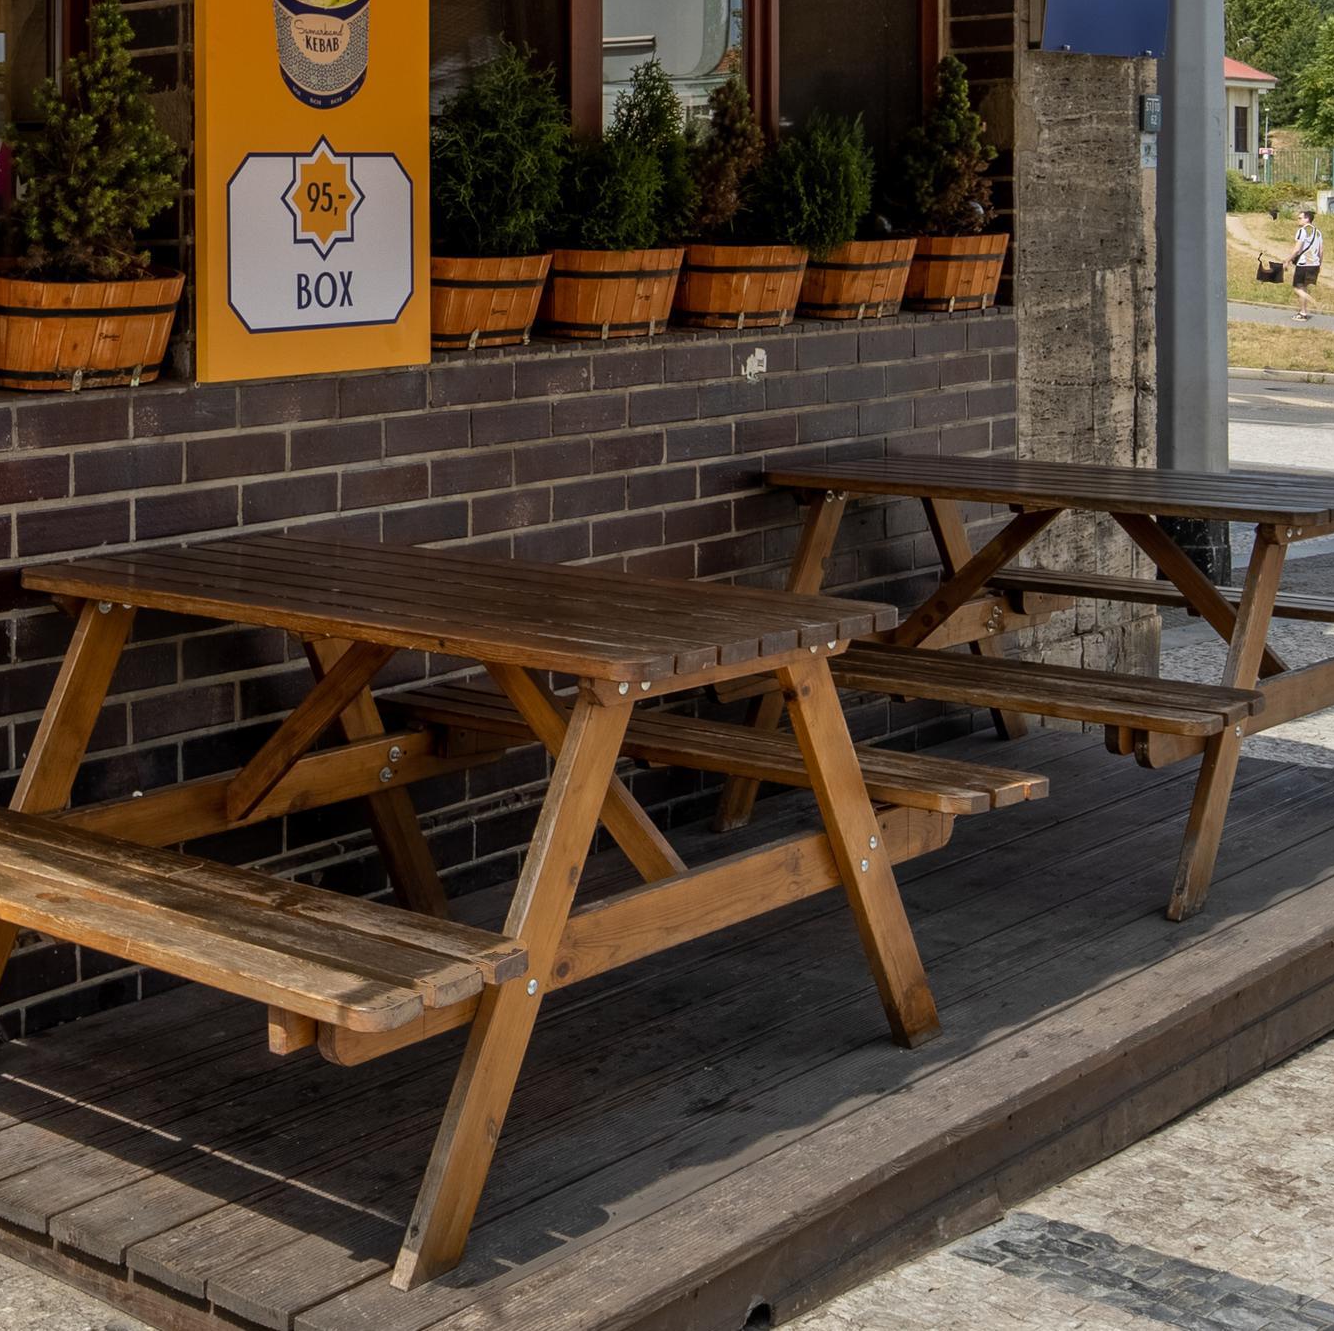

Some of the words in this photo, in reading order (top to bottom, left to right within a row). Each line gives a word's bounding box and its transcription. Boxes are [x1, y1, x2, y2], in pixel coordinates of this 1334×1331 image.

[293, 18, 345, 37] Samarkand
[305, 35, 340, 53] KEBAB
[306, 181, 347, 217] 95,-
[297, 270, 354, 310] BOX
